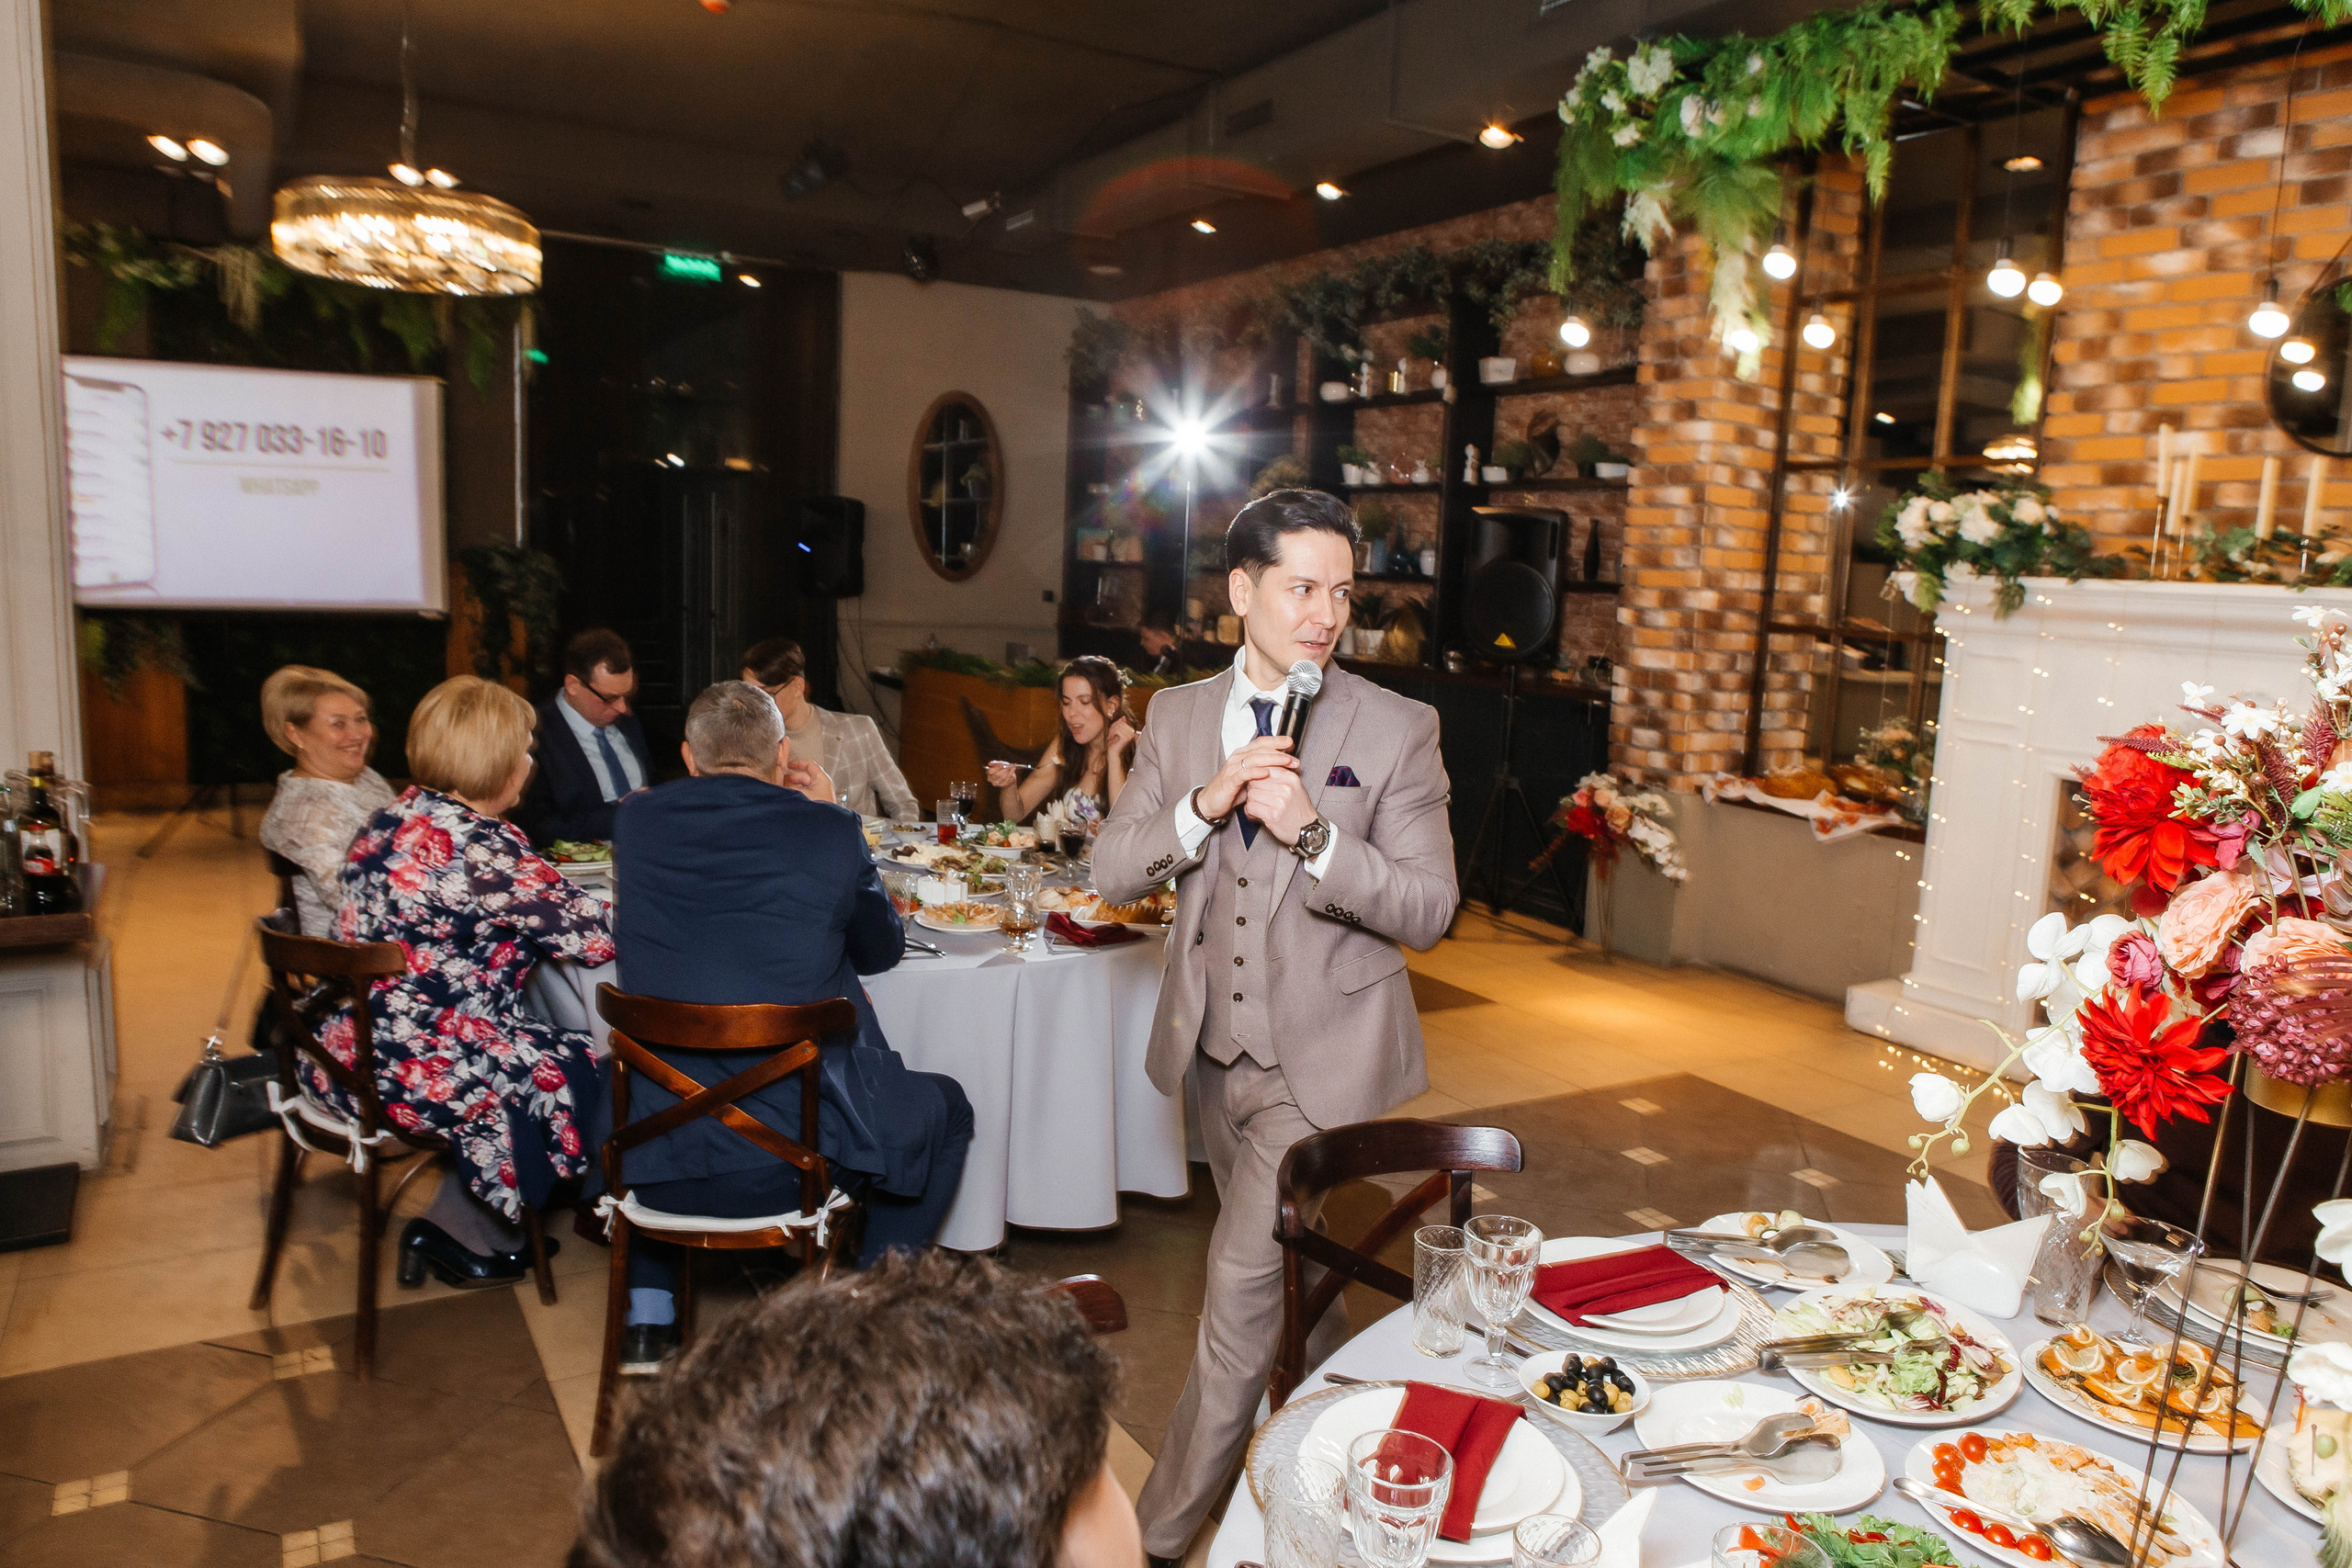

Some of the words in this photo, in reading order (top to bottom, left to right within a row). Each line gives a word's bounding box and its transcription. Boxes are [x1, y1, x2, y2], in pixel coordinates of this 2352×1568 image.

[162, 419, 193, 451] +7
[201, 420, 249, 453] 927
[257, 423, 388, 458] 033-16-10
